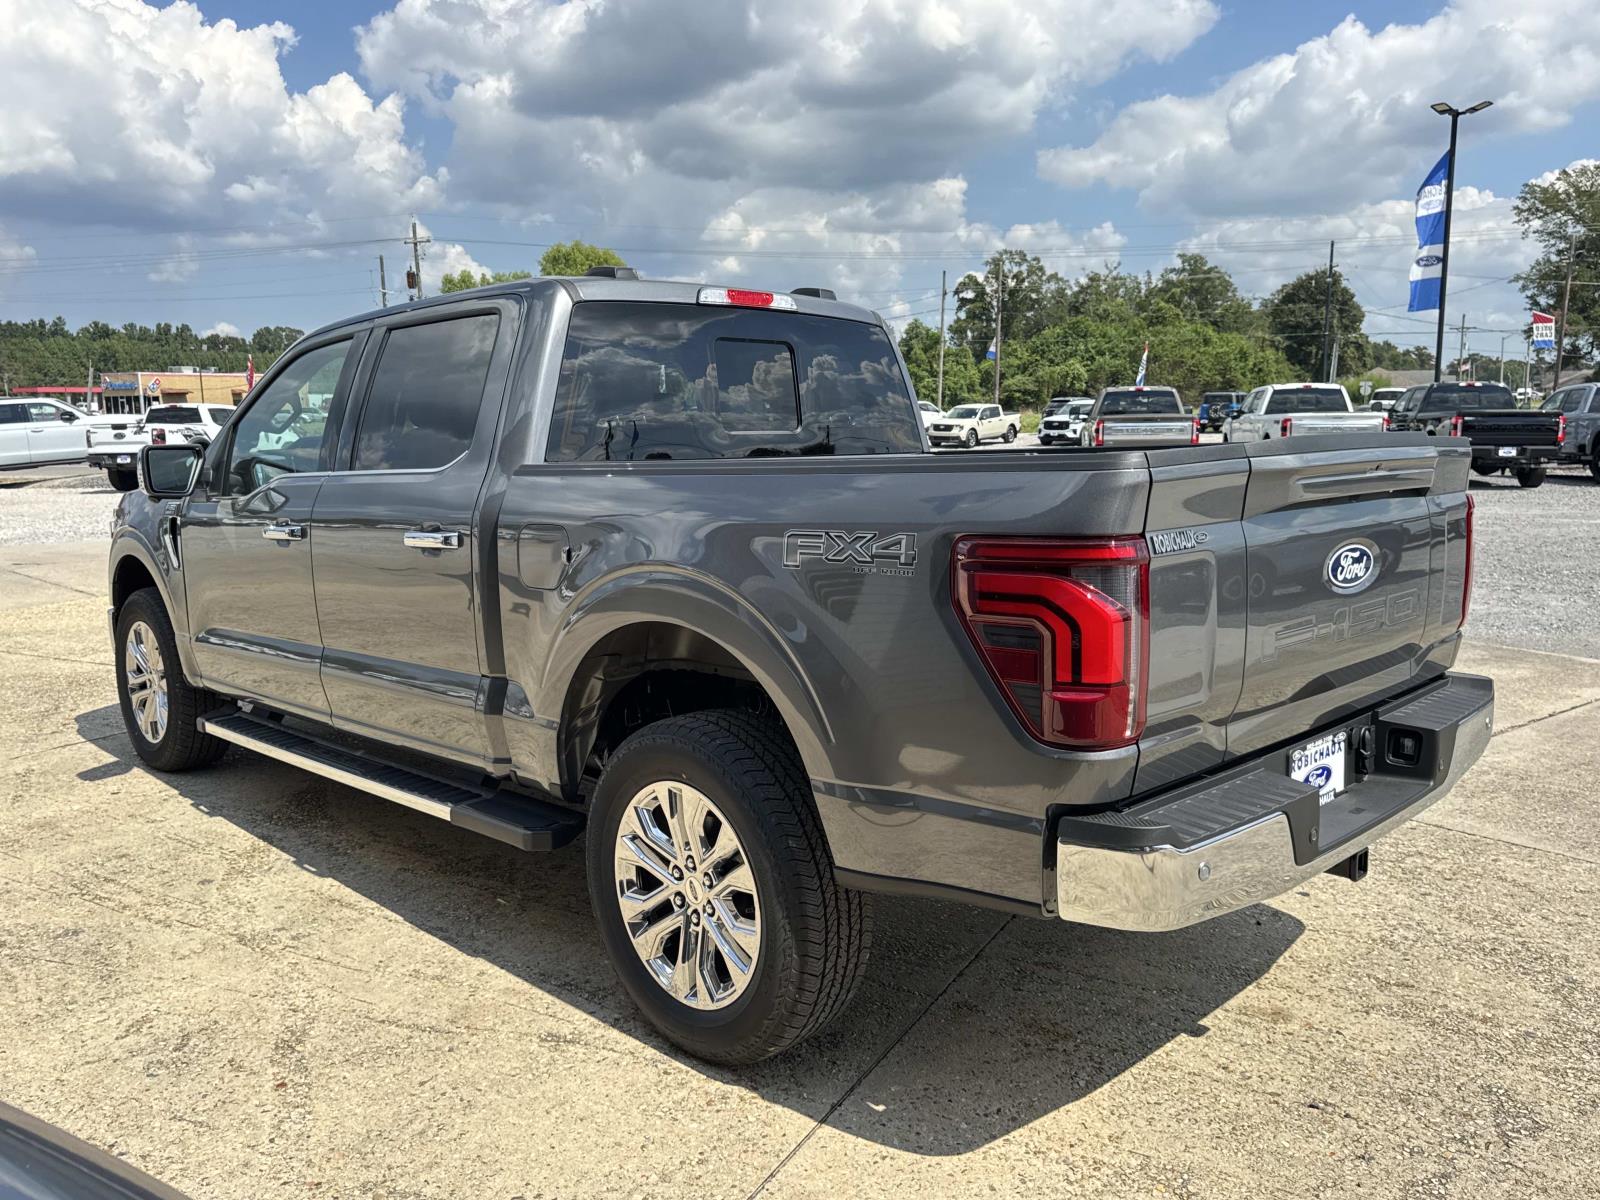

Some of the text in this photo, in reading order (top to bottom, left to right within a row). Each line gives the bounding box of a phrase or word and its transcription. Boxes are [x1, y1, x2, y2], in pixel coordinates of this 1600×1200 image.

[782, 529, 917, 568] FX4
[1153, 529, 1197, 554] ROBICHAUX
[1337, 551, 1366, 580] Ford
[1260, 587, 1421, 664] F-150
[1291, 740, 1342, 773] ROBICHAUX
